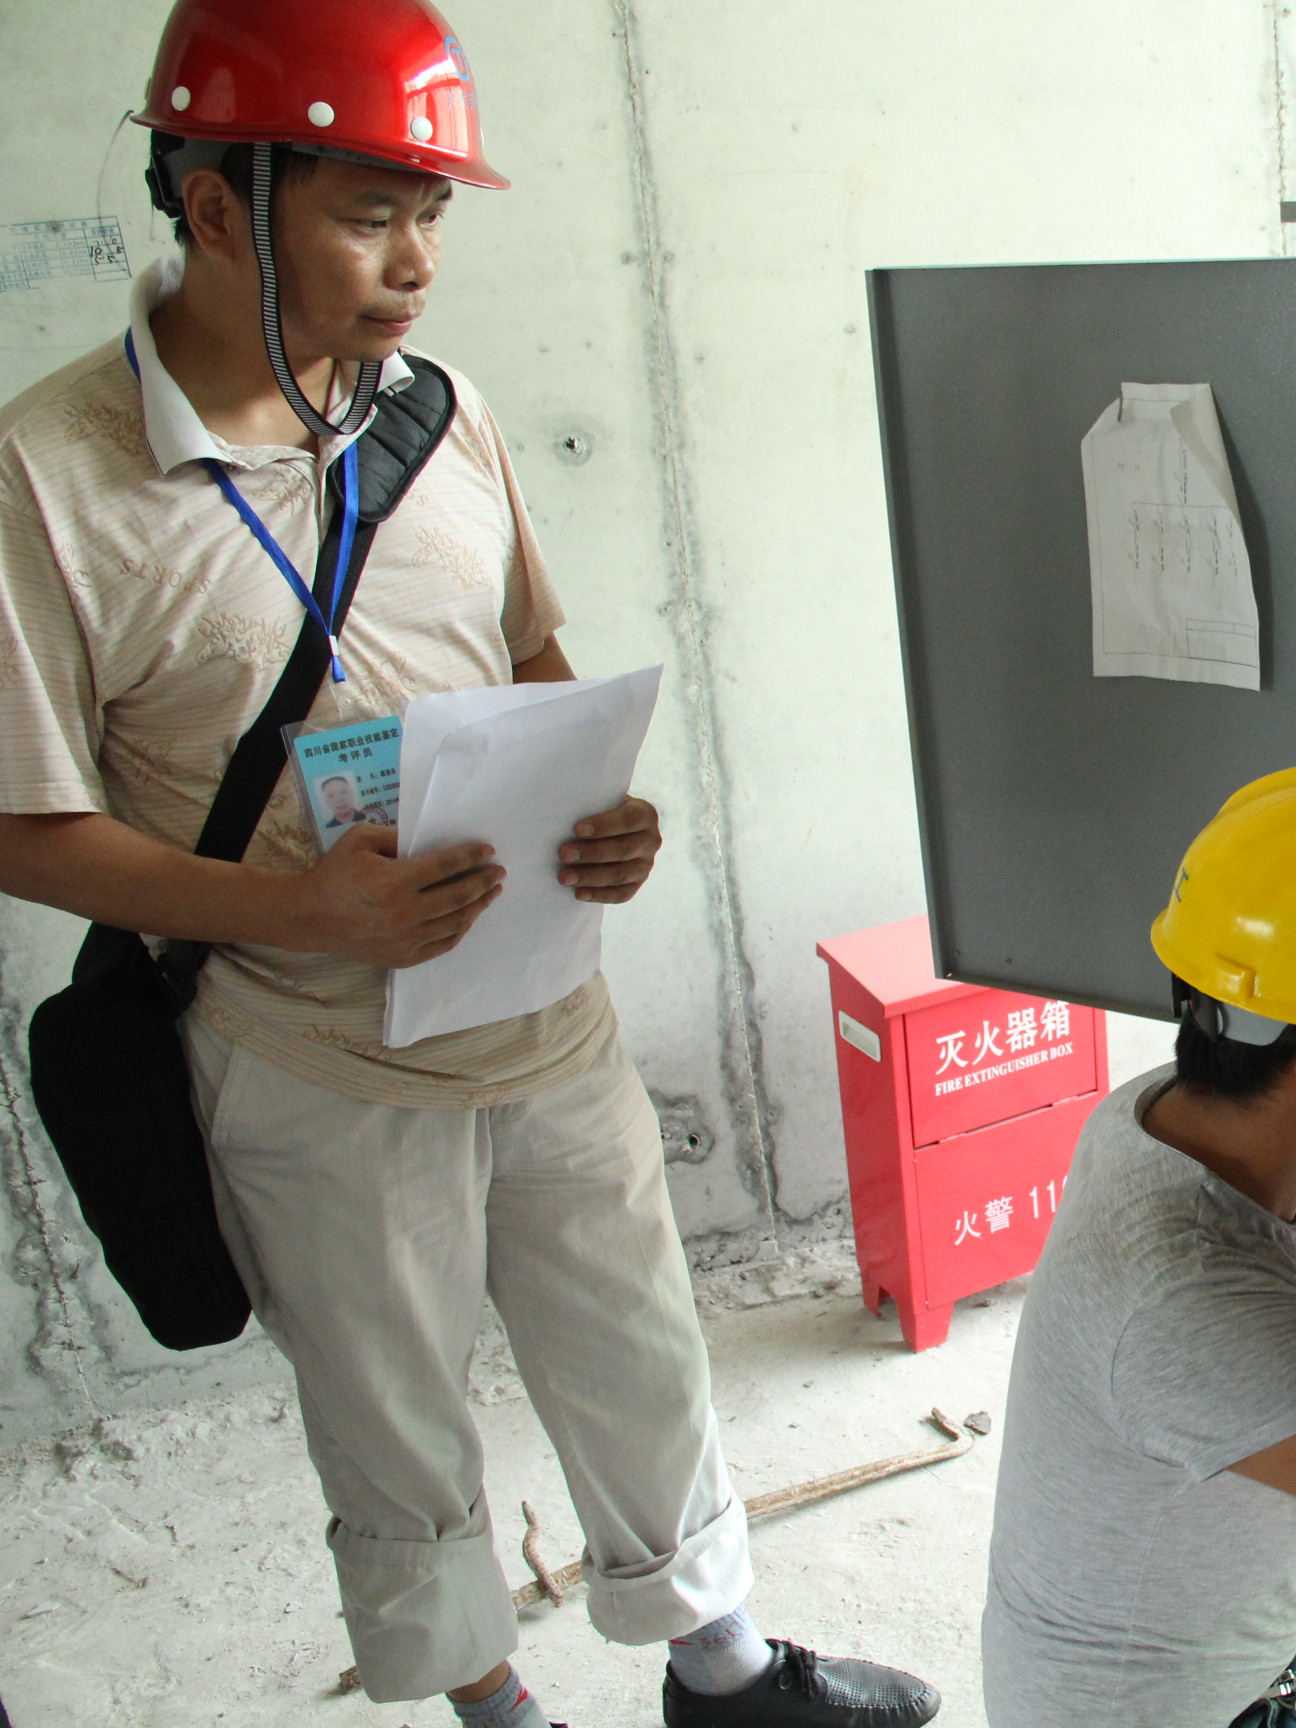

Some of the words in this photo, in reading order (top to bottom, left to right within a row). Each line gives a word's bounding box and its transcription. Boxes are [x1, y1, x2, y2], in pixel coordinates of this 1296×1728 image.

[304, 728, 399, 758] 四川省国家职业技能鉴定
[338, 747, 373, 763] 考评员
[935, 1000, 1070, 1076] 灭火器箱
[935, 1076, 963, 1096] FIRE
[964, 1050, 1049, 1087] EXTINGUISHER
[1049, 1042, 1073, 1062] BOX
[954, 1196, 1013, 1246] 火警
[1029, 1176, 1069, 1220] 11
